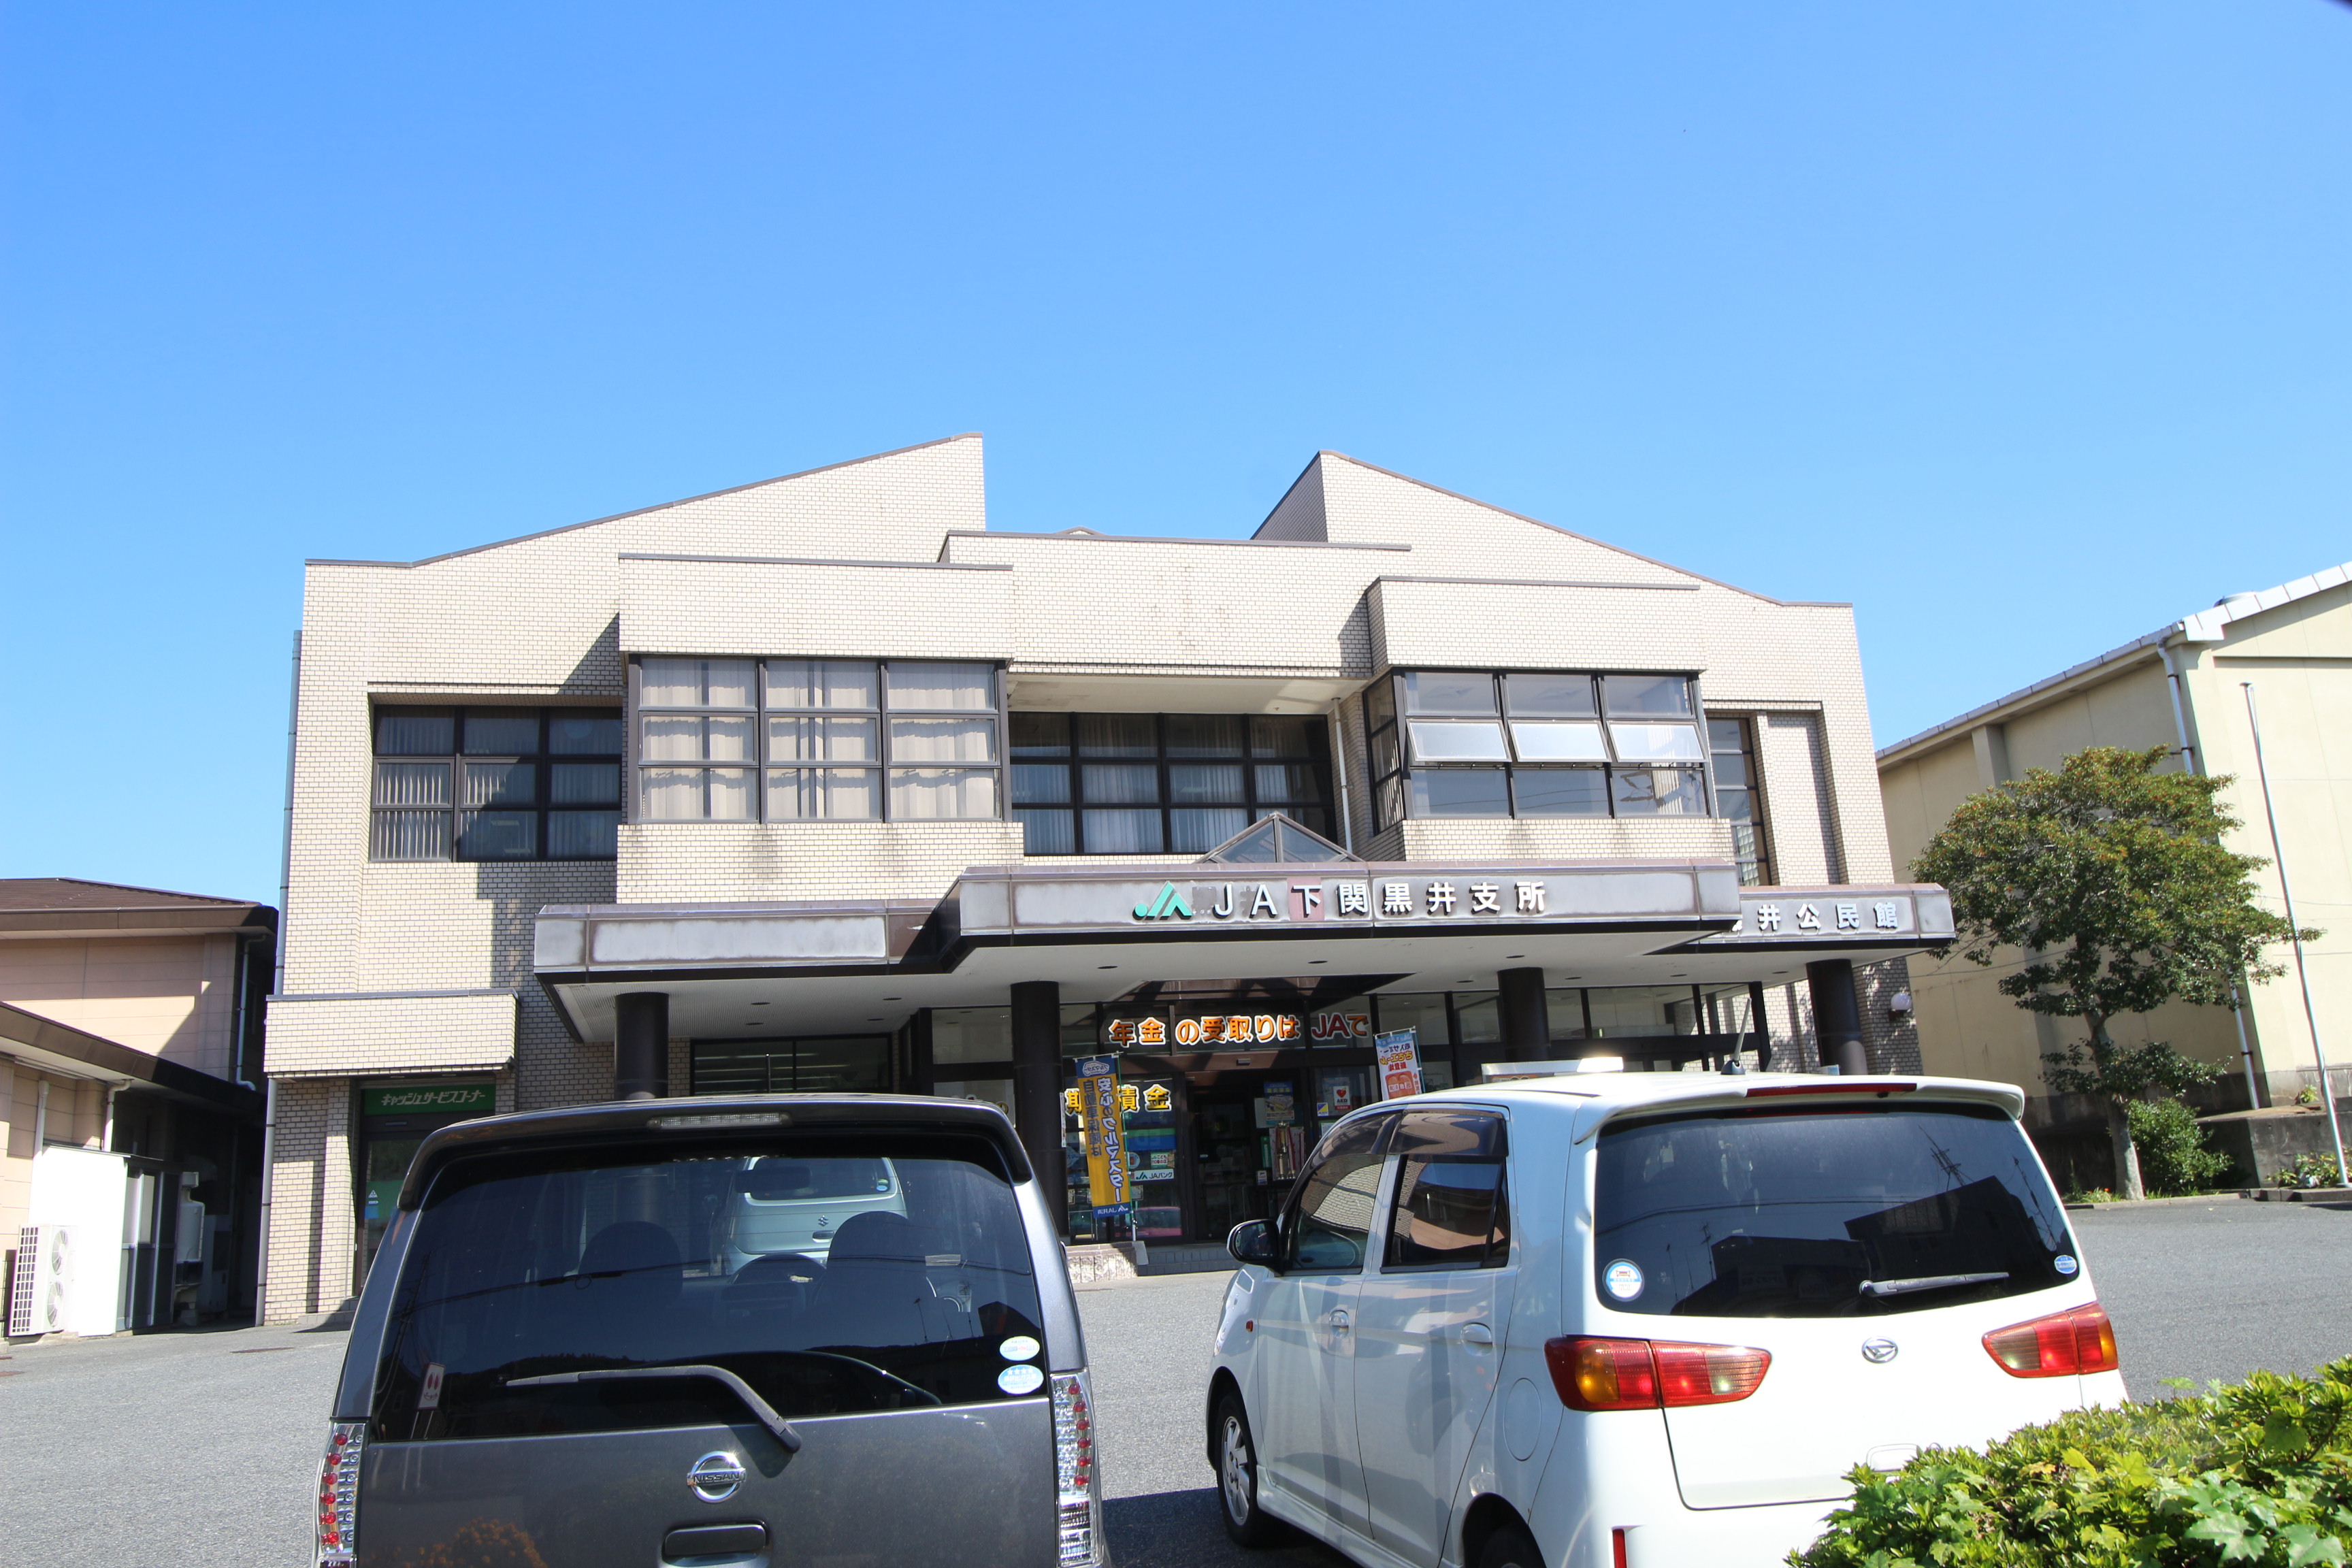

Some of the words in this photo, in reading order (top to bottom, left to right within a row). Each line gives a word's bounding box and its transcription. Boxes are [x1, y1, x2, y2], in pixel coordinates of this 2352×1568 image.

[1213, 881, 1546, 916] JA下関黒井支所
[1732, 902, 1899, 932] 井公民館
[380, 1090, 486, 1106] キャッシュサービスコーナー
[693, 1472, 740, 1484] NISSAN
